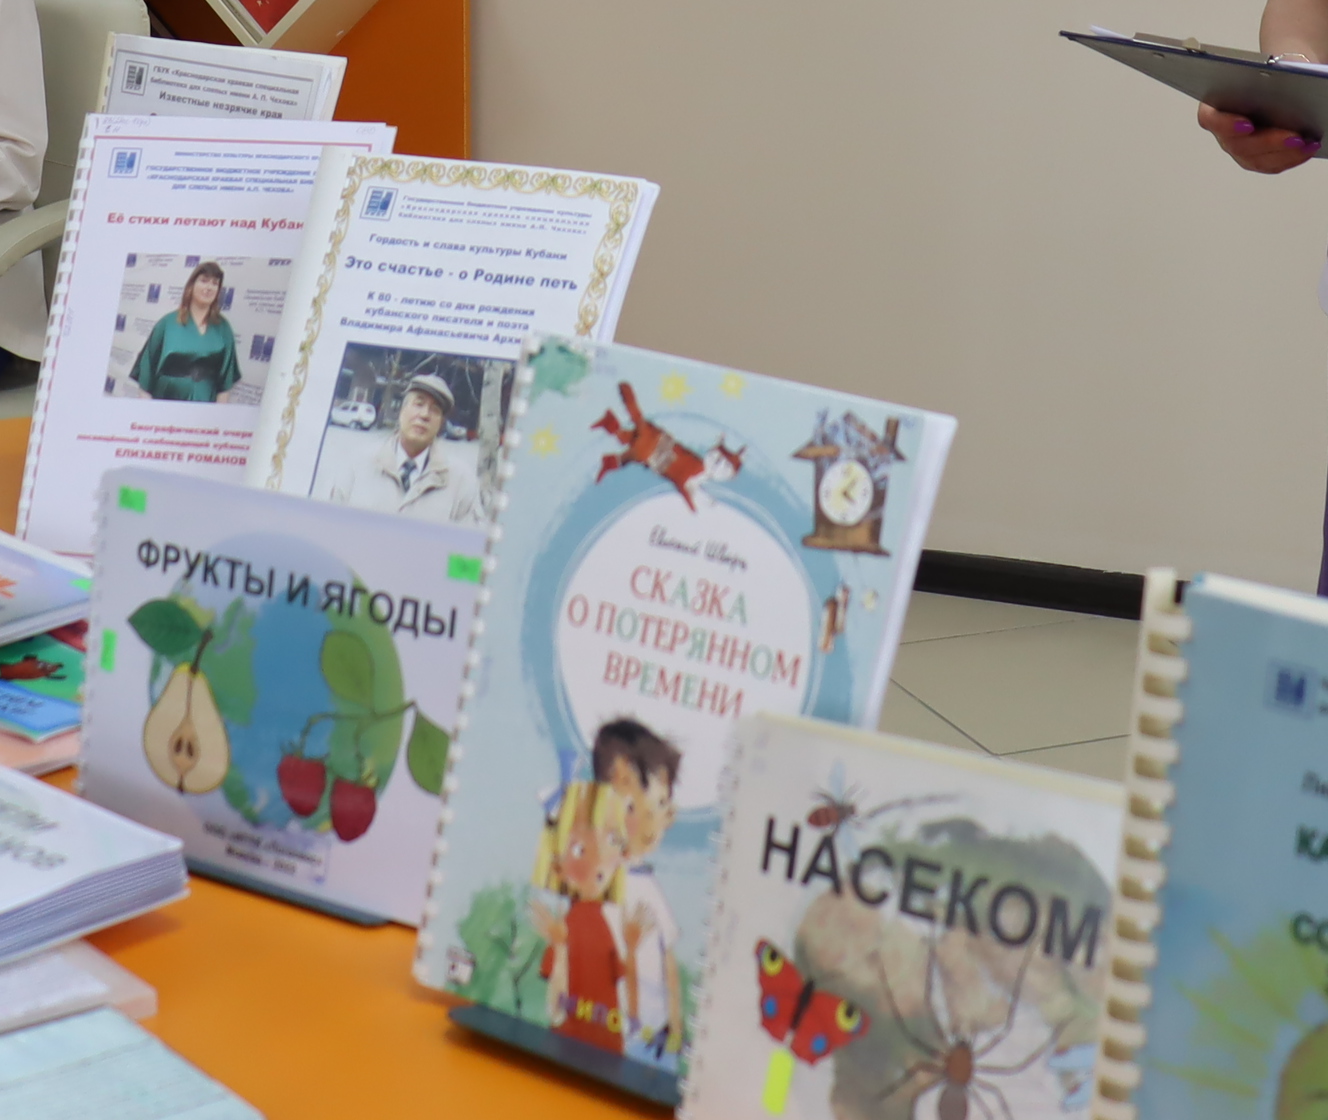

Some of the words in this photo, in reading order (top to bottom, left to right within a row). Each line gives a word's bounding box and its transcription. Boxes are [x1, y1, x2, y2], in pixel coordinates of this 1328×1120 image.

[153, 66, 170, 74] ГБУК
[171, 69, 226, 83] «Краснодарская
[227, 79, 253, 89] краевая
[255, 83, 299, 95] специальная
[159, 91, 210, 107] Известные
[213, 101, 257, 115] незрячие
[260, 107, 283, 119] края
[107, 211, 125, 224] Её
[128, 213, 170, 226] стихи
[173, 215, 226, 229] летают
[230, 219, 257, 231] над
[369, 233, 420, 248] Гордость
[423, 239, 430, 248] и
[433, 240, 467, 252] слава
[469, 243, 522, 258] культуры
[525, 247, 568, 261] Кубани
[344, 256, 373, 271] Это
[377, 260, 445, 278] счастье
[458, 269, 468, 280] о
[473, 268, 535, 287] Родине
[540, 276, 579, 291] петь
[365, 306, 429, 321] кубанского
[432, 312, 484, 327] писателя
[487, 318, 494, 327] и
[497, 320, 530, 331] поэта
[367, 291, 375, 301] К
[377, 292, 392, 303] 80
[400, 296, 437, 308] летию
[439, 299, 453, 309] со
[455, 301, 476, 313] дня
[478, 303, 536, 318] рождения
[340, 316, 404, 335] Владимира
[406, 324, 490, 343] Афанасьевича
[115, 447, 184, 461] ЕЛИЗАВЕТЕ
[187, 452, 247, 466] РОМАНОВ
[137, 539, 274, 600] ФРУКТЫ
[285, 573, 311, 607] И
[322, 583, 457, 640] ЯГОДЫ
[629, 564, 748, 625] СКАЗКА
[567, 594, 589, 627] О
[595, 599, 802, 690] ПОТЕРЯННОМ
[603, 649, 745, 719] ВРЕМЕНИ
[760, 817, 1102, 969] НАСЕКОМ
